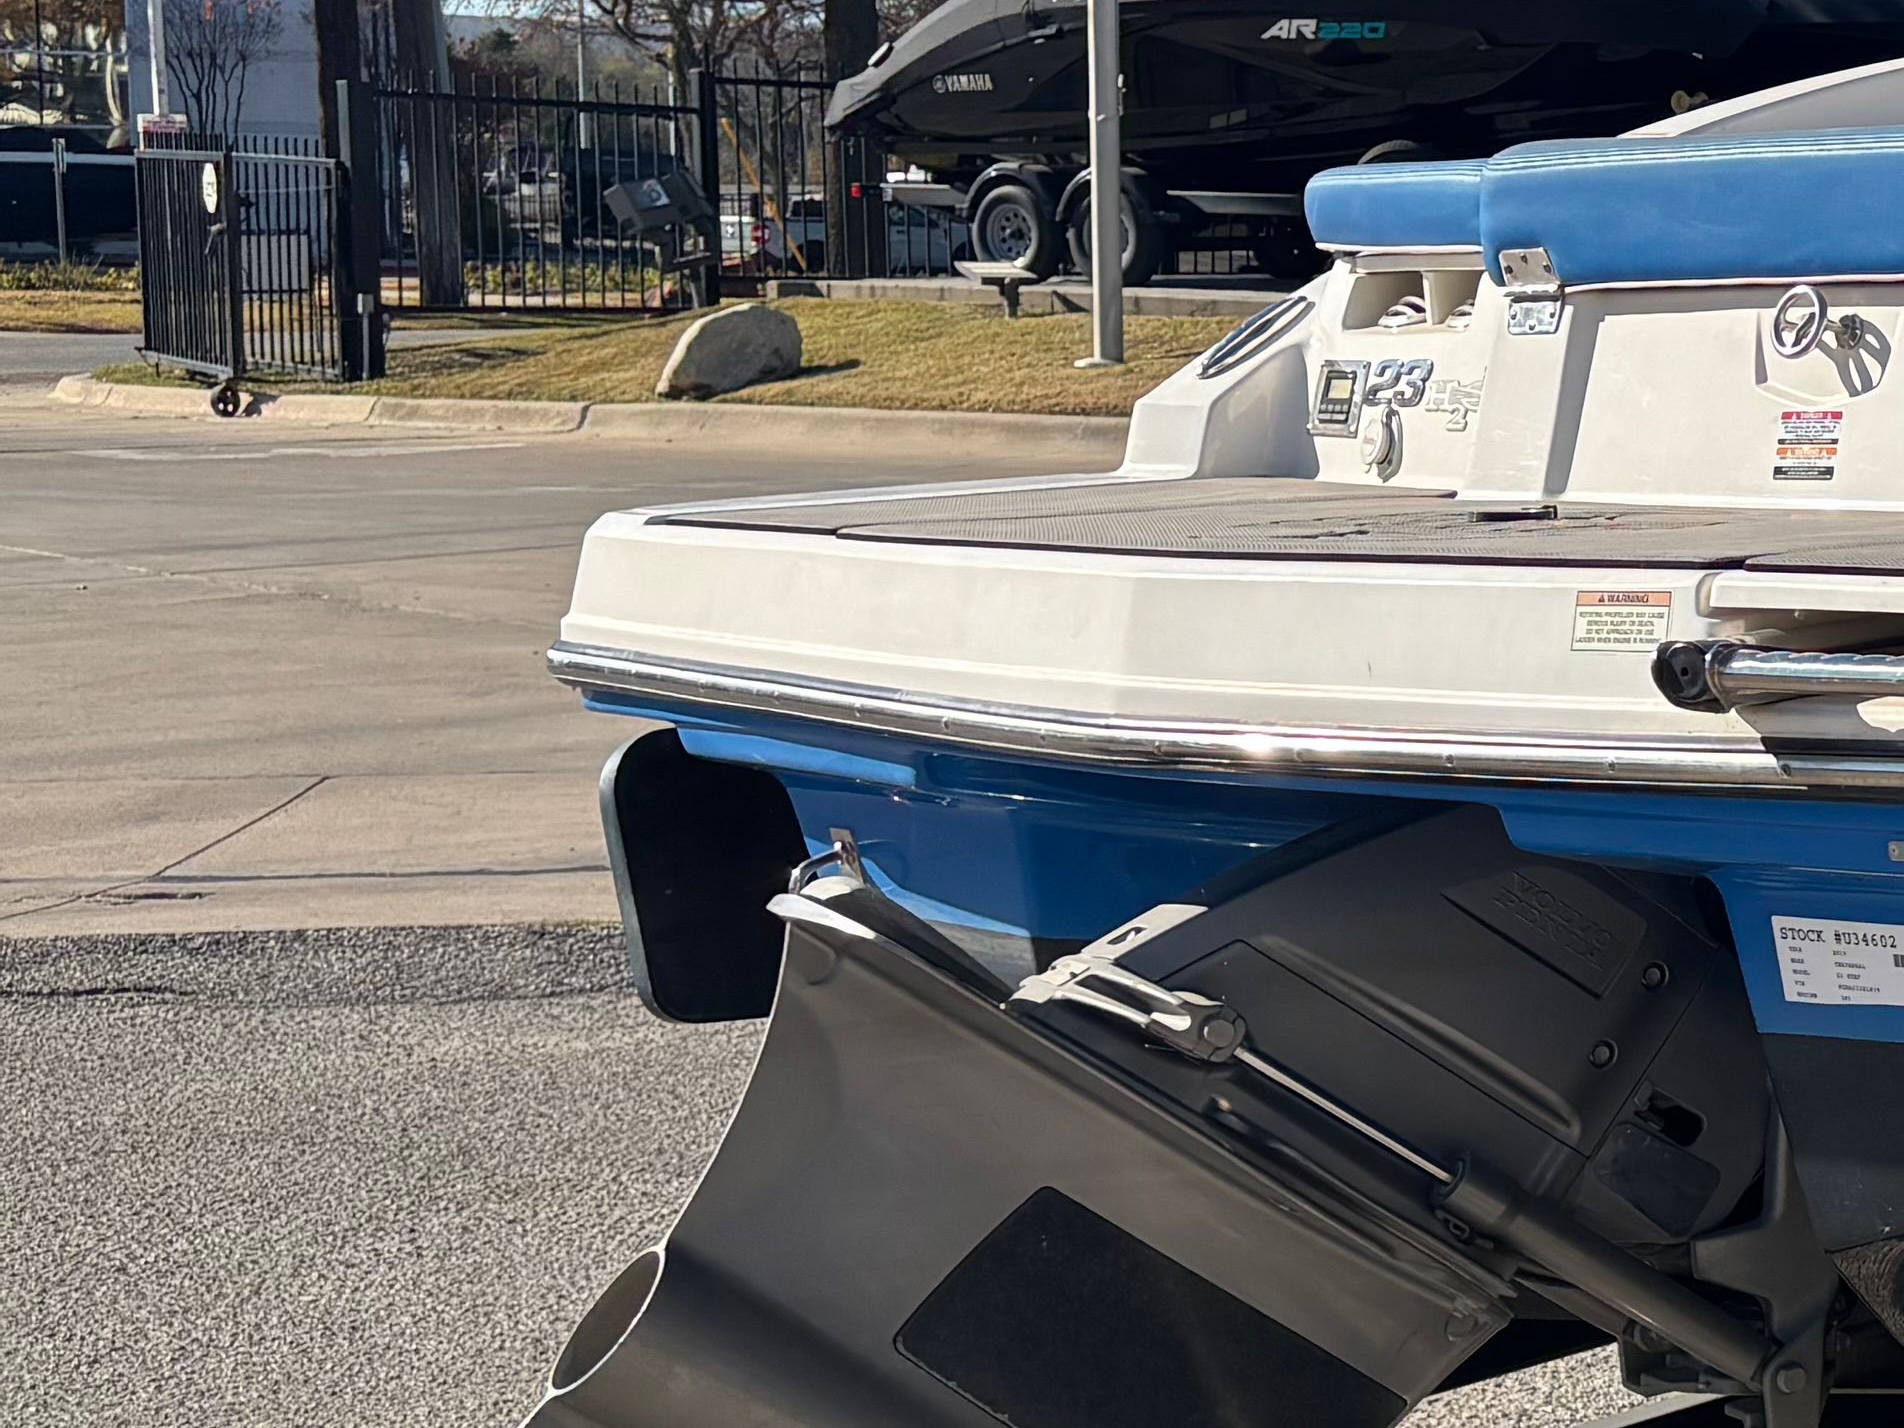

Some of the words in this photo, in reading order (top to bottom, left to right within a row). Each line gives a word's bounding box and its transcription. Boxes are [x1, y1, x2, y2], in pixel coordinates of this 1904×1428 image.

[1260, 18, 1386, 40] AR220
[944, 74, 994, 92] YAMAHA
[1364, 358, 1434, 408] 23
[1607, 594, 1649, 603] WARNING
[1780, 927, 1826, 944] STOCK
[1834, 929, 1897, 949] #U34602
